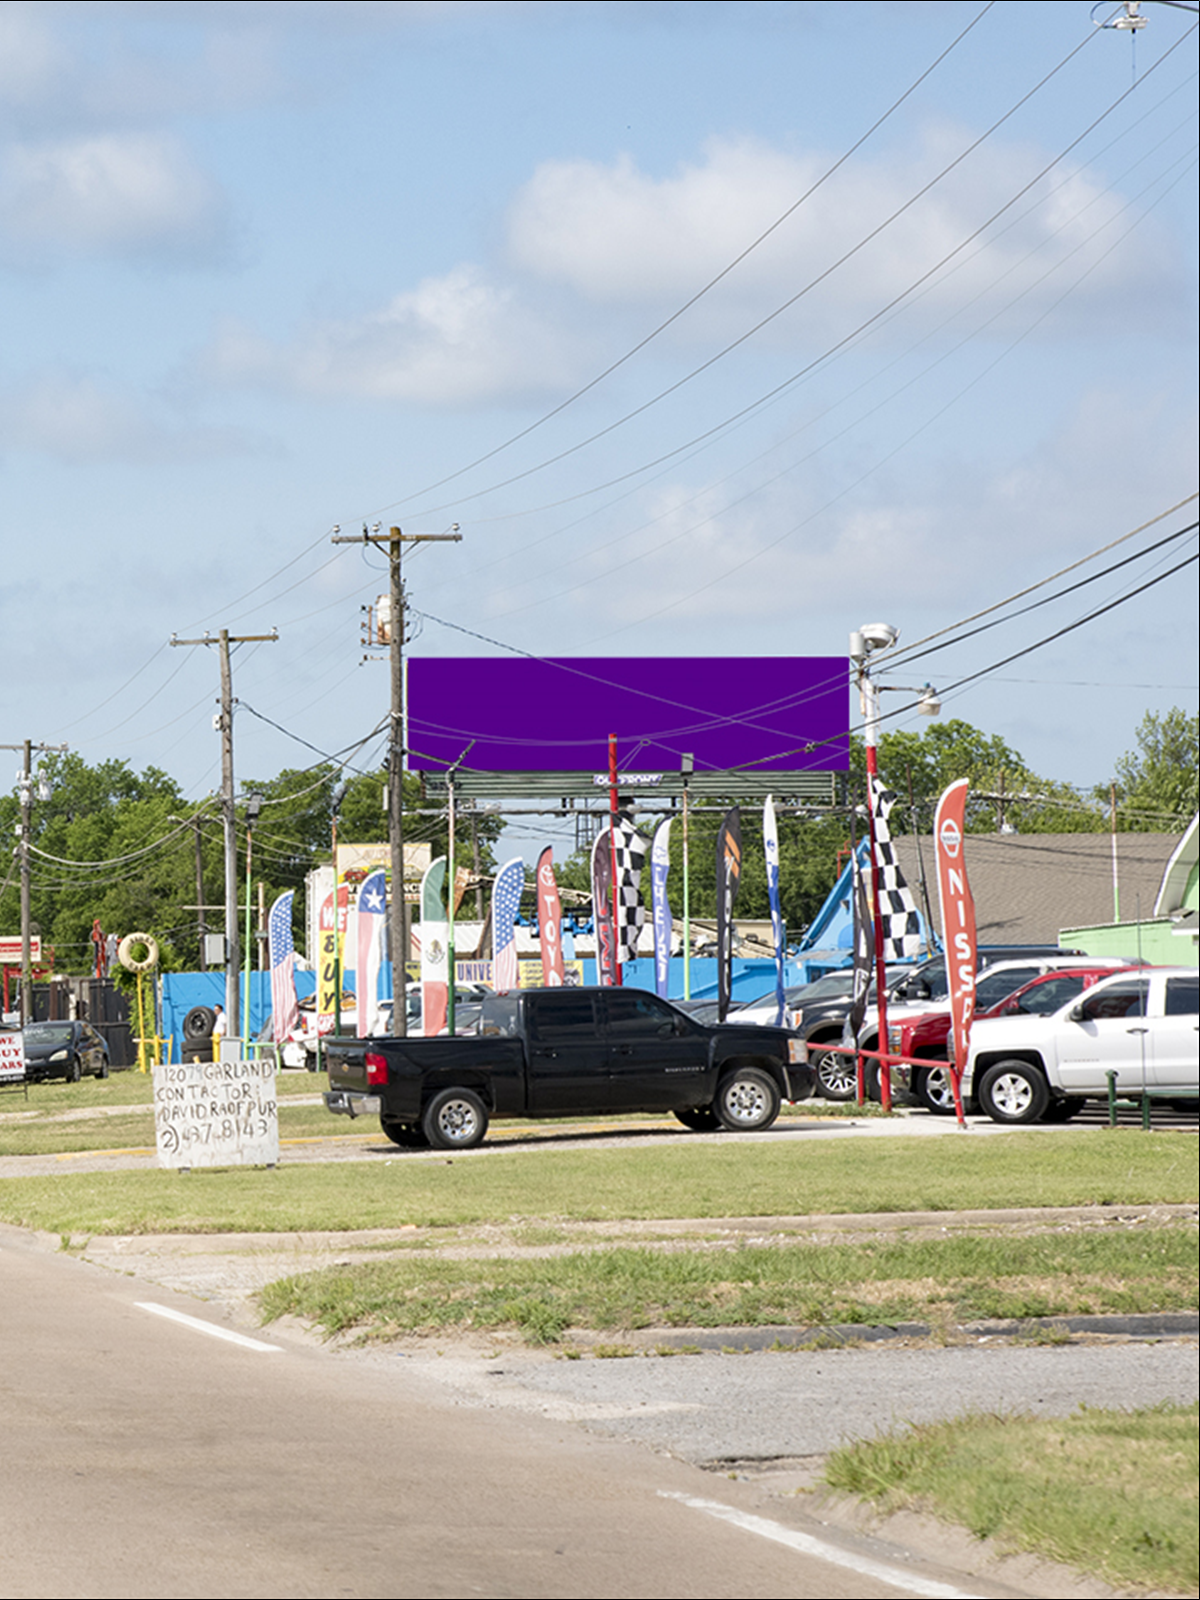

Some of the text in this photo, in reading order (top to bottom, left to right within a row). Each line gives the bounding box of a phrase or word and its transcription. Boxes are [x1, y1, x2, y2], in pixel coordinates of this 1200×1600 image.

[322, 906, 347, 931] WE
[457, 963, 492, 981] UNIVE
[203, 1062, 273, 1081] GARLAND
